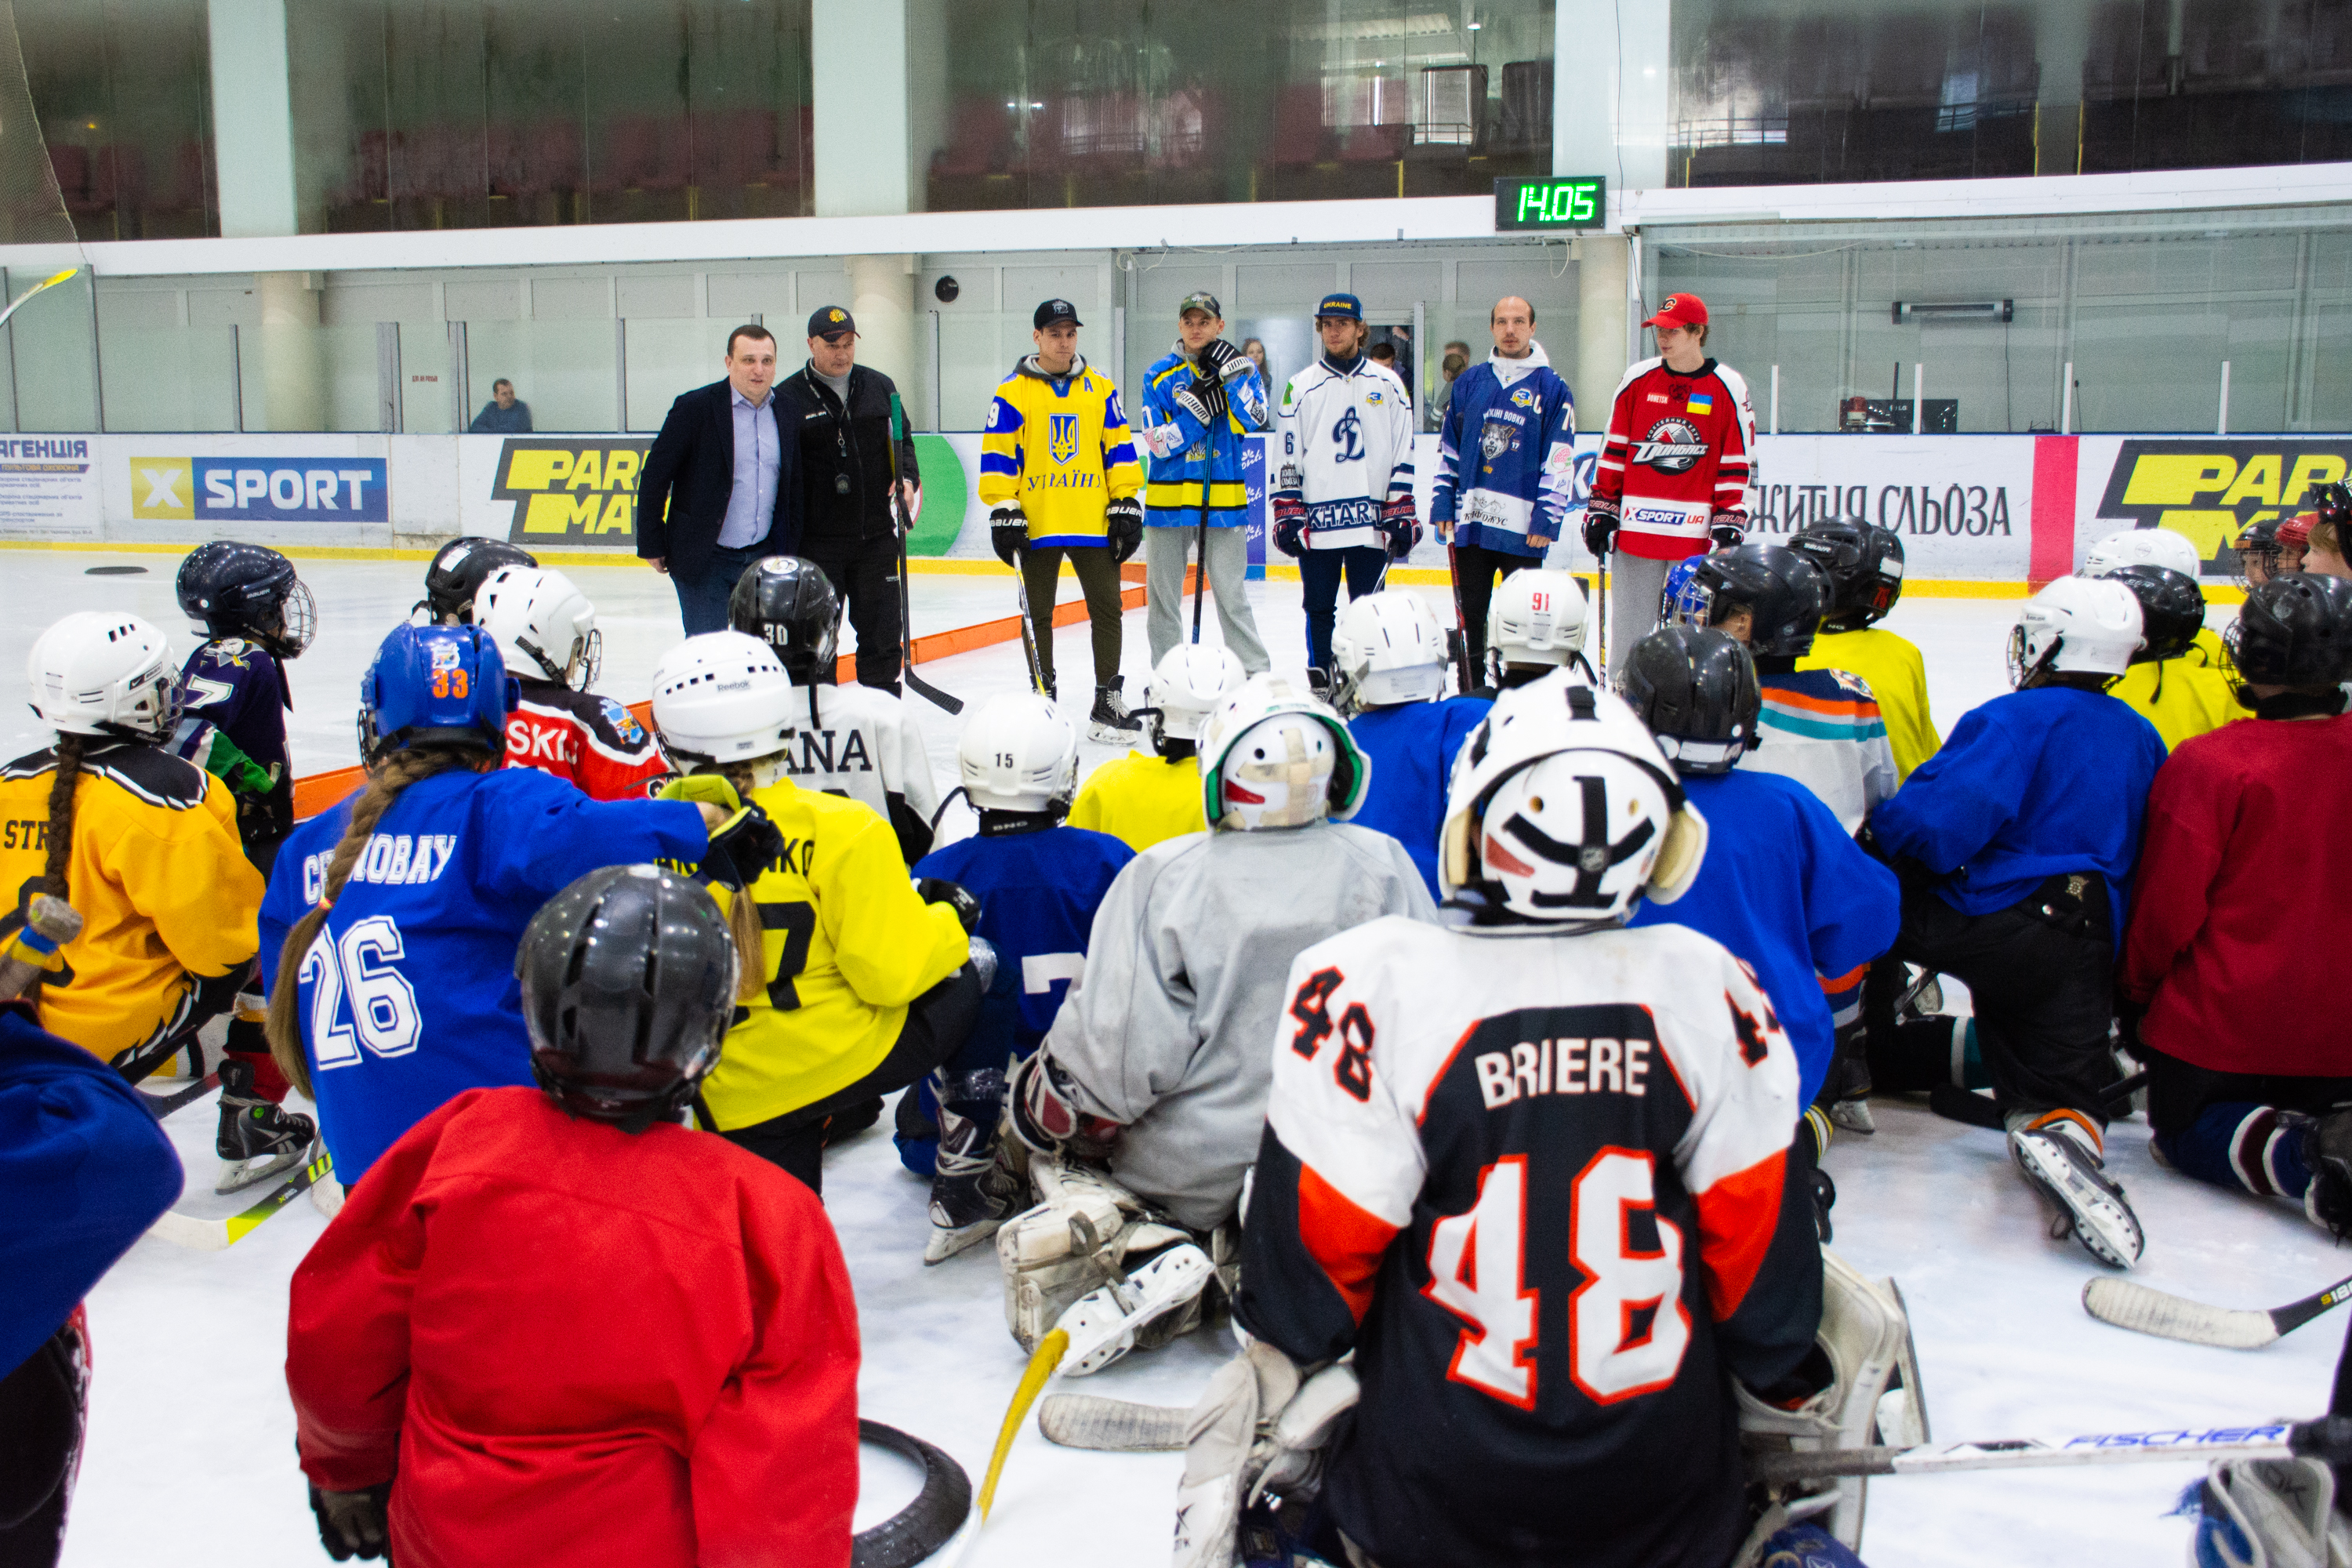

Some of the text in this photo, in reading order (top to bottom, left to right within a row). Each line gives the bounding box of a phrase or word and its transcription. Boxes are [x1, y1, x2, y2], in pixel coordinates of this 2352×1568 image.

[1518, 184, 1597, 222] 14.05
[1084, 377, 1094, 393] A
[1646, 393, 1669, 404] DONETSK
[1504, 411, 1526, 426] ВОВКИ
[140, 469, 372, 510] X SPORT
[2122, 455, 2351, 505] PAR
[1106, 505, 1142, 517] BAUER
[1878, 483, 2012, 536] СЛЬОЗА
[989, 517, 1028, 528] BAUER
[1532, 593, 1549, 612] 91
[763, 624, 788, 645] 30
[432, 670, 468, 699] 33
[717, 680, 750, 692] Reebok
[995, 753, 1014, 768] 15
[299, 915, 423, 1071] 26
[1290, 965, 1374, 1102] 48
[1475, 1036, 1650, 1110] BRIERE
[1419, 1145, 1693, 1411] 48
[2063, 1425, 2285, 1450] FISCHER
